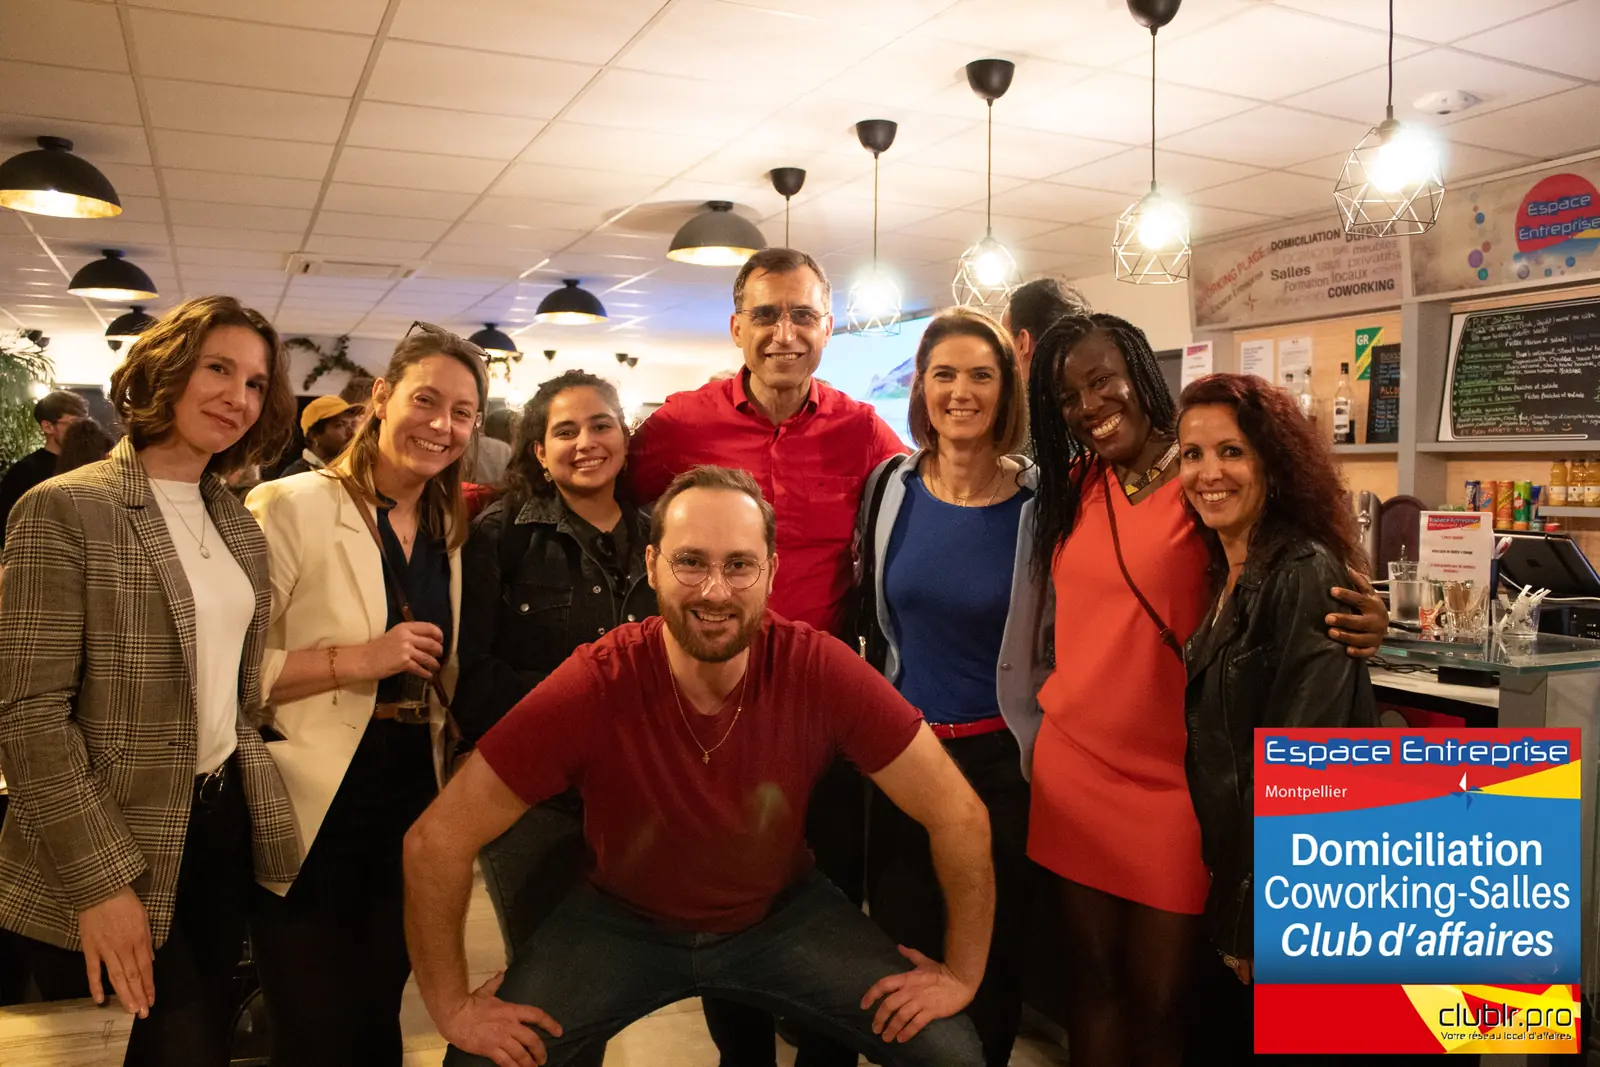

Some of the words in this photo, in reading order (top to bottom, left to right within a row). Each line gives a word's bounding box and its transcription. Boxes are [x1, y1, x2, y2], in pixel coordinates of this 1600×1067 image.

[1527, 195, 1591, 216] Espace
[1519, 217, 1600, 240] Entreprise
[1270, 228, 1341, 251] DOMICILIATION
[1270, 265, 1311, 281] Salles
[1284, 276, 1329, 293] Formation
[1331, 269, 1368, 284] locaux
[1327, 278, 1395, 298] COWORKING
[1356, 334, 1370, 345] GR
